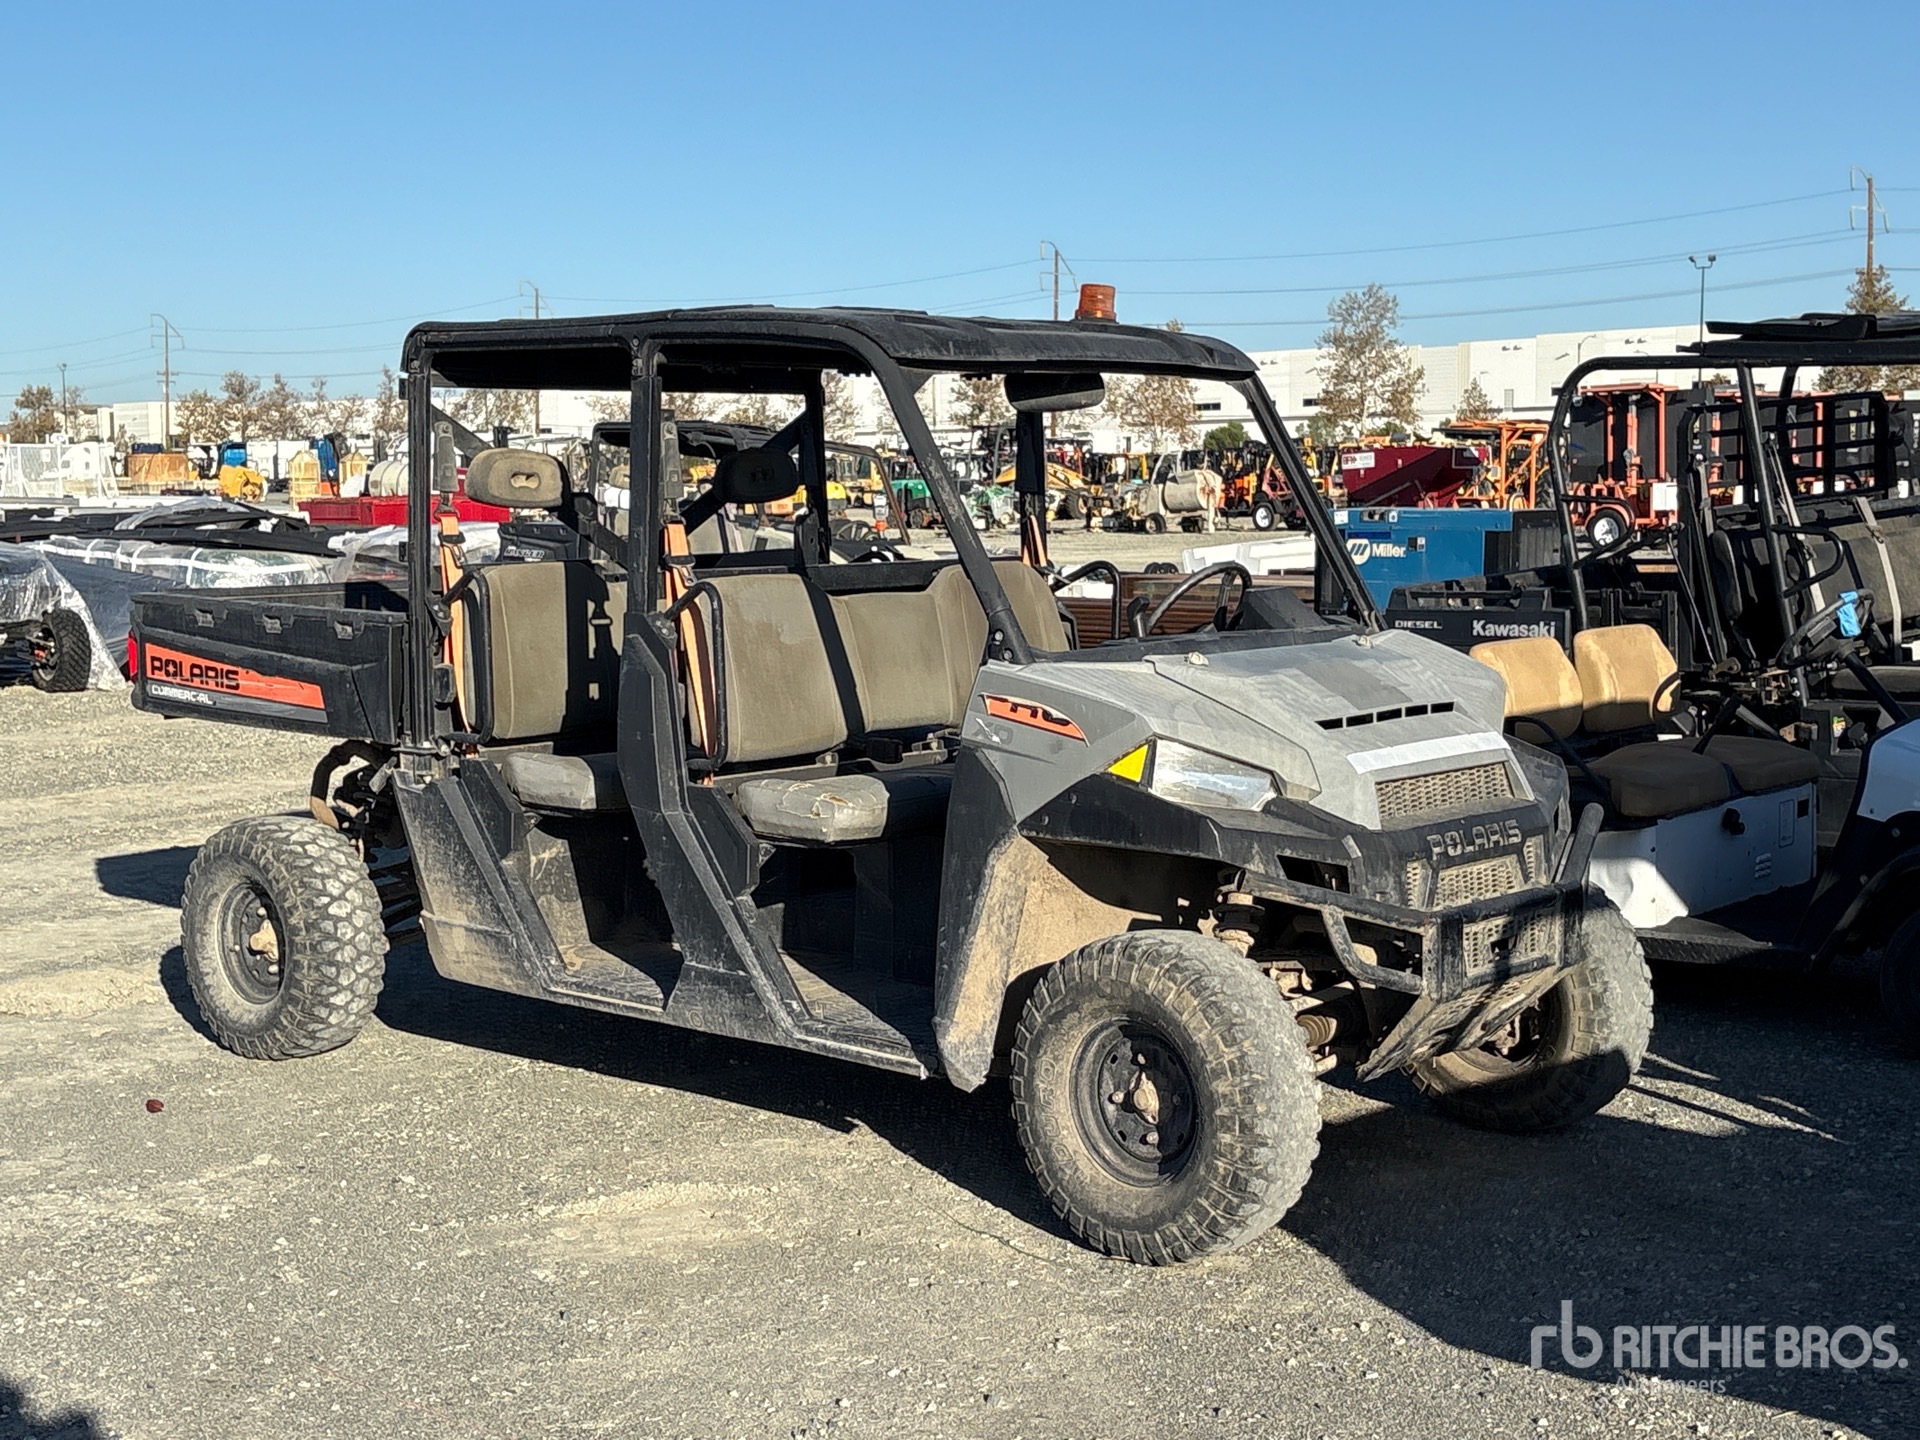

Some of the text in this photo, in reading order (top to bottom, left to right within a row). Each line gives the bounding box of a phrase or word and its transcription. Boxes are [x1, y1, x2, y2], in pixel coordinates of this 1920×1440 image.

[1394, 619, 1443, 630] DIESEL
[1472, 619, 1556, 638] Kawasaki
[150, 655, 241, 691] POLARIS
[1426, 819, 1522, 861] POLARIS
